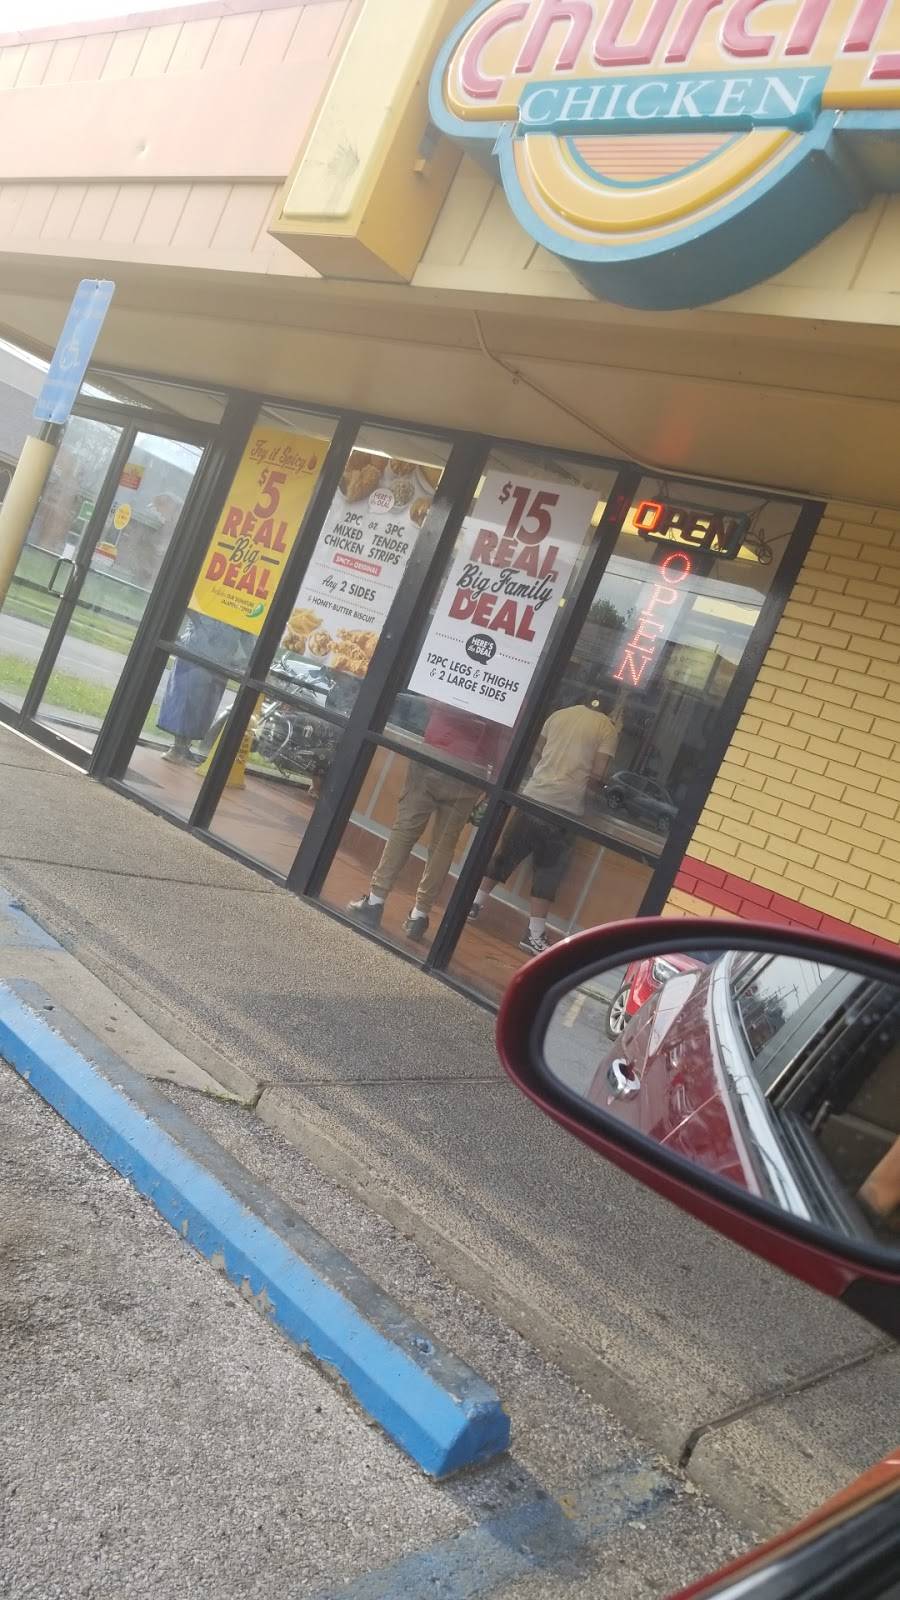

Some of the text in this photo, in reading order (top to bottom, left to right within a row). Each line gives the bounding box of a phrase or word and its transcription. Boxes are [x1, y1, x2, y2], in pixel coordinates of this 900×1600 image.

[520, 75, 816, 125] CHICKEN
[280, 446, 306, 475] Spicy
[253, 468, 288, 519] $5
[498, 481, 560, 545] $15
[222, 506, 288, 553] REAL
[333, 523, 409, 554] MIXED TENDER
[344, 511, 363, 526] 2PC
[385, 522, 405, 538] 3PC
[632, 501, 737, 552] OPEN
[229, 535, 260, 573] Big
[324, 534, 401, 565] CHICKEN STRIPS
[470, 528, 560, 583] REAL
[205, 552, 271, 600] DEAL
[322, 574, 377, 602] Any 2 SIDES
[456, 563, 552, 611] Big Family
[312, 596, 353, 617] HONEY-BUTTER
[353, 610, 376, 624] BISCUIT
[448, 587, 537, 642] DEAL
[613, 552, 692, 687] OPEN
[471, 637, 494, 650] HERE'S
[475, 647, 492, 657] DEAL
[426, 652, 520, 693] 12PC LEGS & THIGHS
[429, 668, 437, 678] &
[438, 670, 445, 681] 2
[447, 673, 478, 692] LARGE
[479, 684, 507, 702] SIDES
